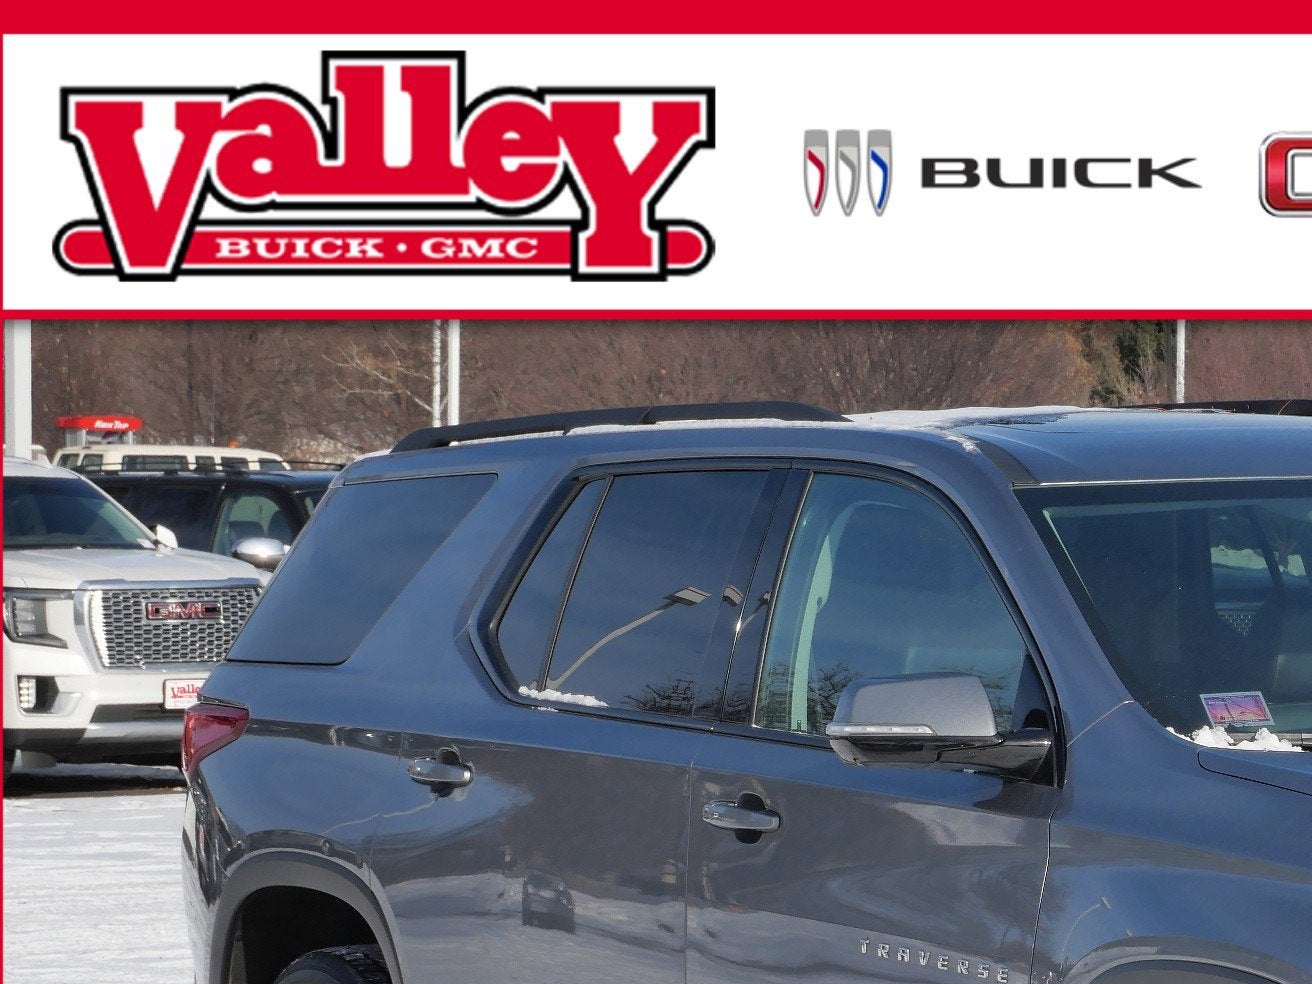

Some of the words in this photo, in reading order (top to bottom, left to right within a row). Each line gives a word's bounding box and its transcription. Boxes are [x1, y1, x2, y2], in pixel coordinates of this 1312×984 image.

[147, 602, 221, 619] GMC
[170, 683, 201, 699] Valle
[859, 937, 1009, 984] TRAVERSE
